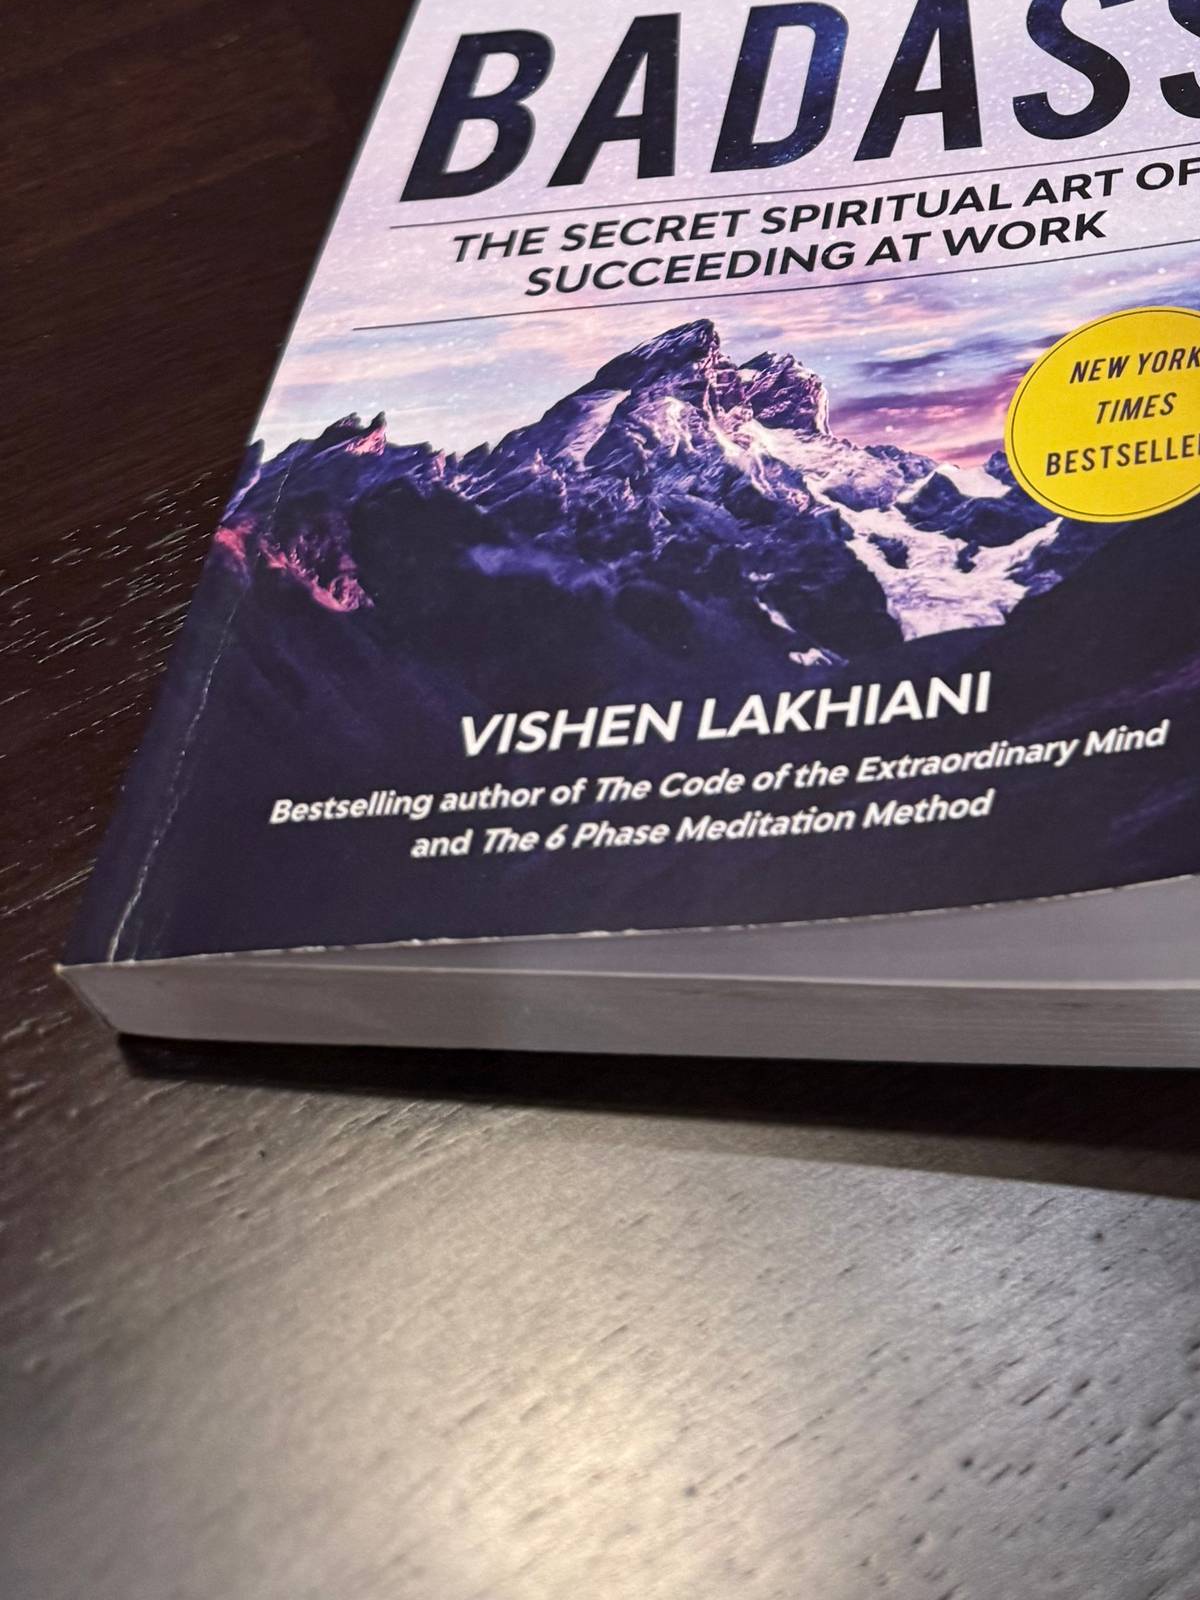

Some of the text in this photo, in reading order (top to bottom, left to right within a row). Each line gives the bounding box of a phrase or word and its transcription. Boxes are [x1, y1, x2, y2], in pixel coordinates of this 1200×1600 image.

[453, 226, 549, 263] THE
[559, 211, 749, 251] SECRET
[761, 185, 1010, 236] SPIRITUAL
[1021, 170, 1125, 205] ART
[525, 210, 1108, 297] SUCCEEDING AT WORK
[1070, 356, 1129, 384] NEW
[1096, 392, 1177, 425] TIMES
[460, 670, 992, 759] VISHEN LAKHIANI
[269, 719, 1171, 825] Bestselling author of The Code of the Extraordinary Mind
[410, 789, 995, 859] and The 6 Phase Meditation Method
